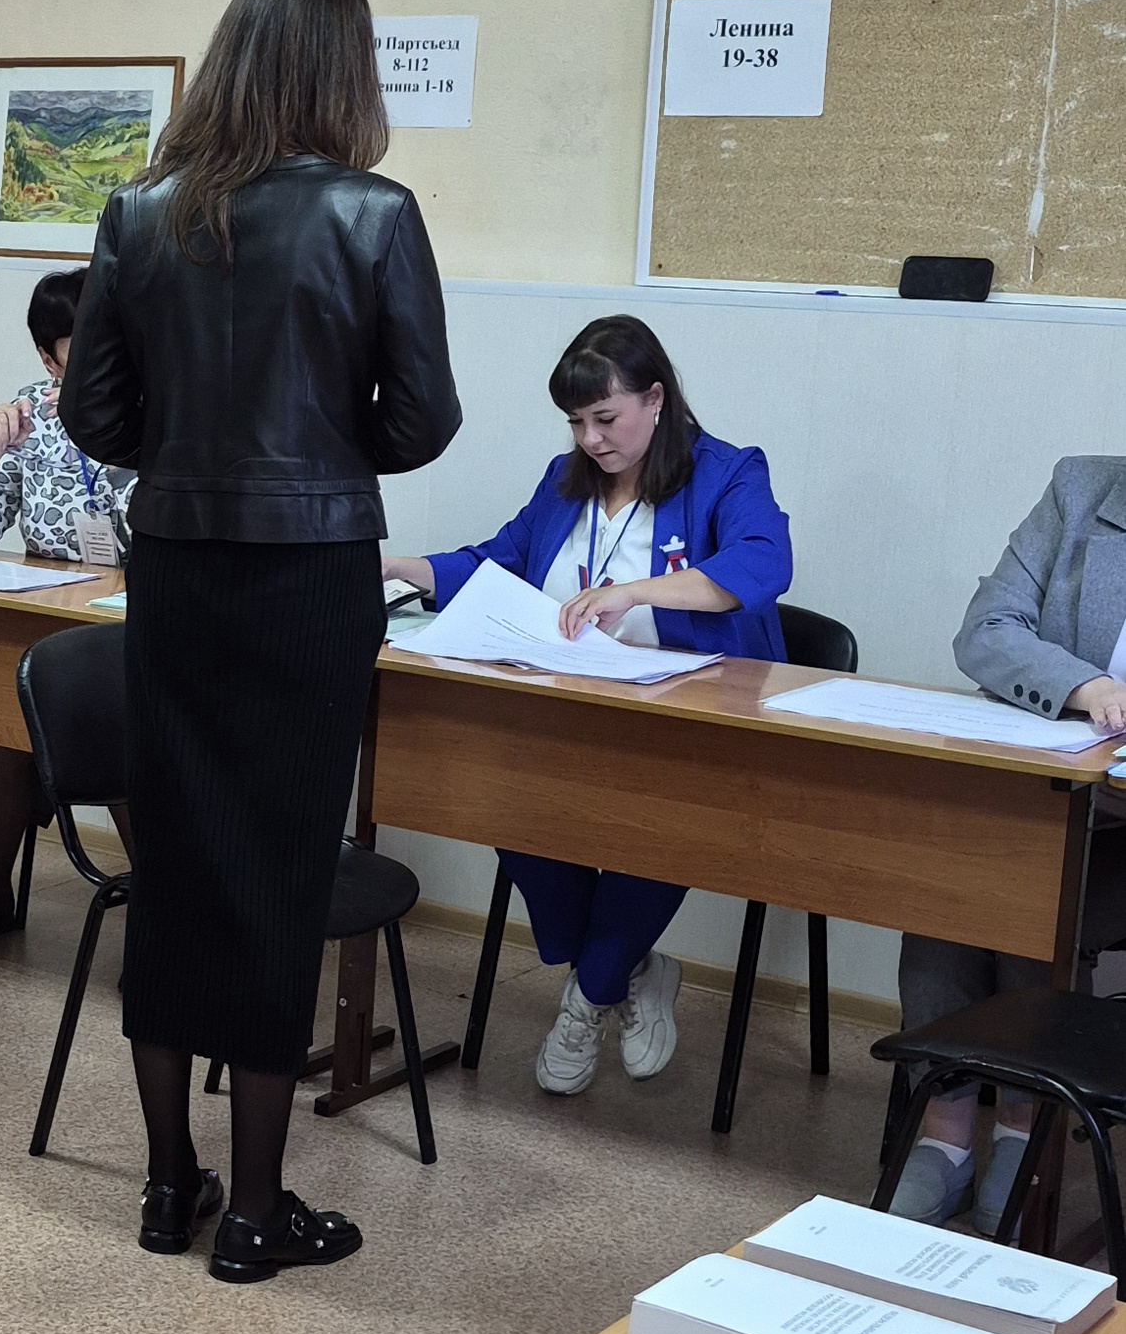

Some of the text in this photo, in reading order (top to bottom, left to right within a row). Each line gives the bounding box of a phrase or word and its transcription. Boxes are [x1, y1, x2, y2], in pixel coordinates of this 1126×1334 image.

[708, 18, 794, 38] Ленина
[374, 36, 460, 54] 0 Партсъезд
[392, 57, 429, 72] 8-112
[721, 47, 779, 68] 19-38
[378, 79, 454, 93] енина 1-18
